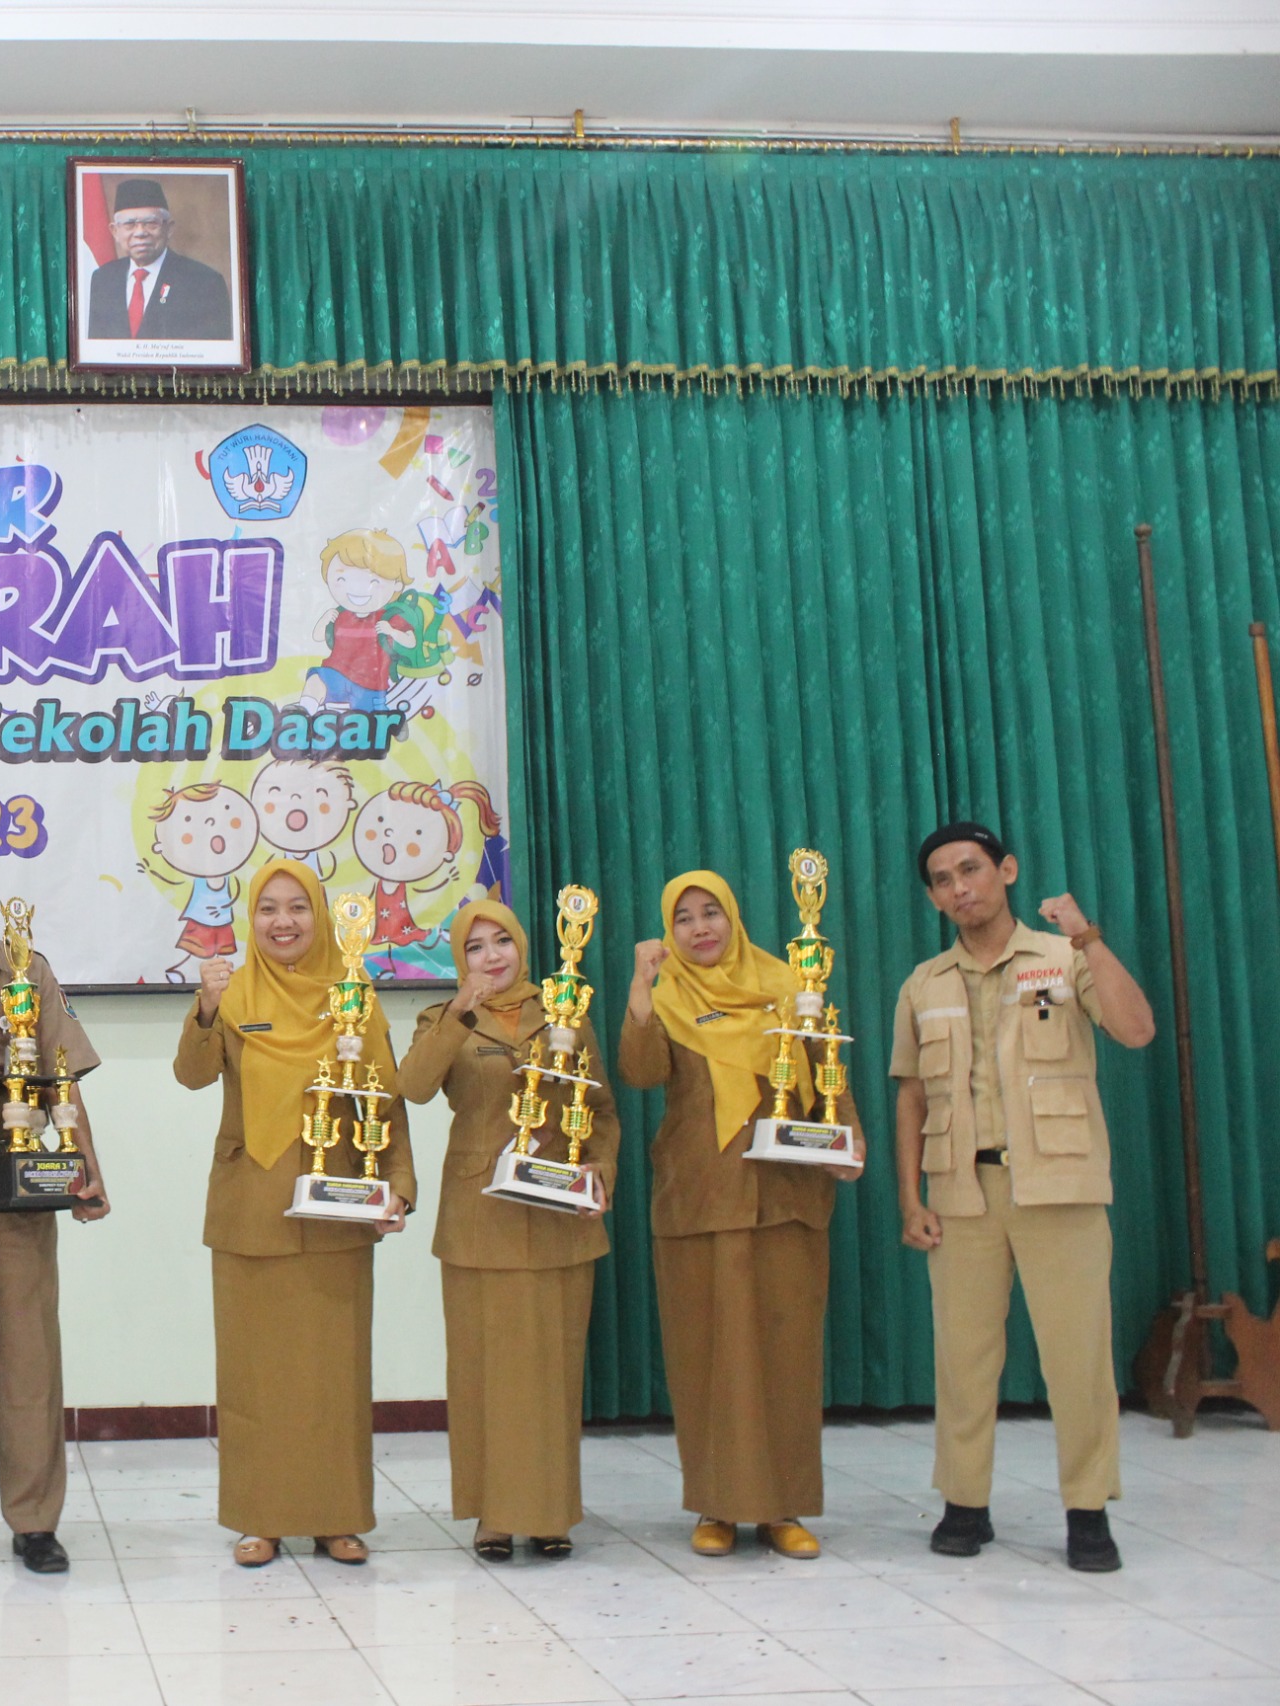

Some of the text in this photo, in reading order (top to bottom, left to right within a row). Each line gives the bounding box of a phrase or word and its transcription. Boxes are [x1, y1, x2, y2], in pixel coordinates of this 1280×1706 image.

[218, 434, 299, 462] TUT WURI HANDAYANI
[221, 696, 407, 761] Dasar
[1017, 967, 1064, 981] MERDEKA
[37, 1162, 67, 1171] JUARA 3
